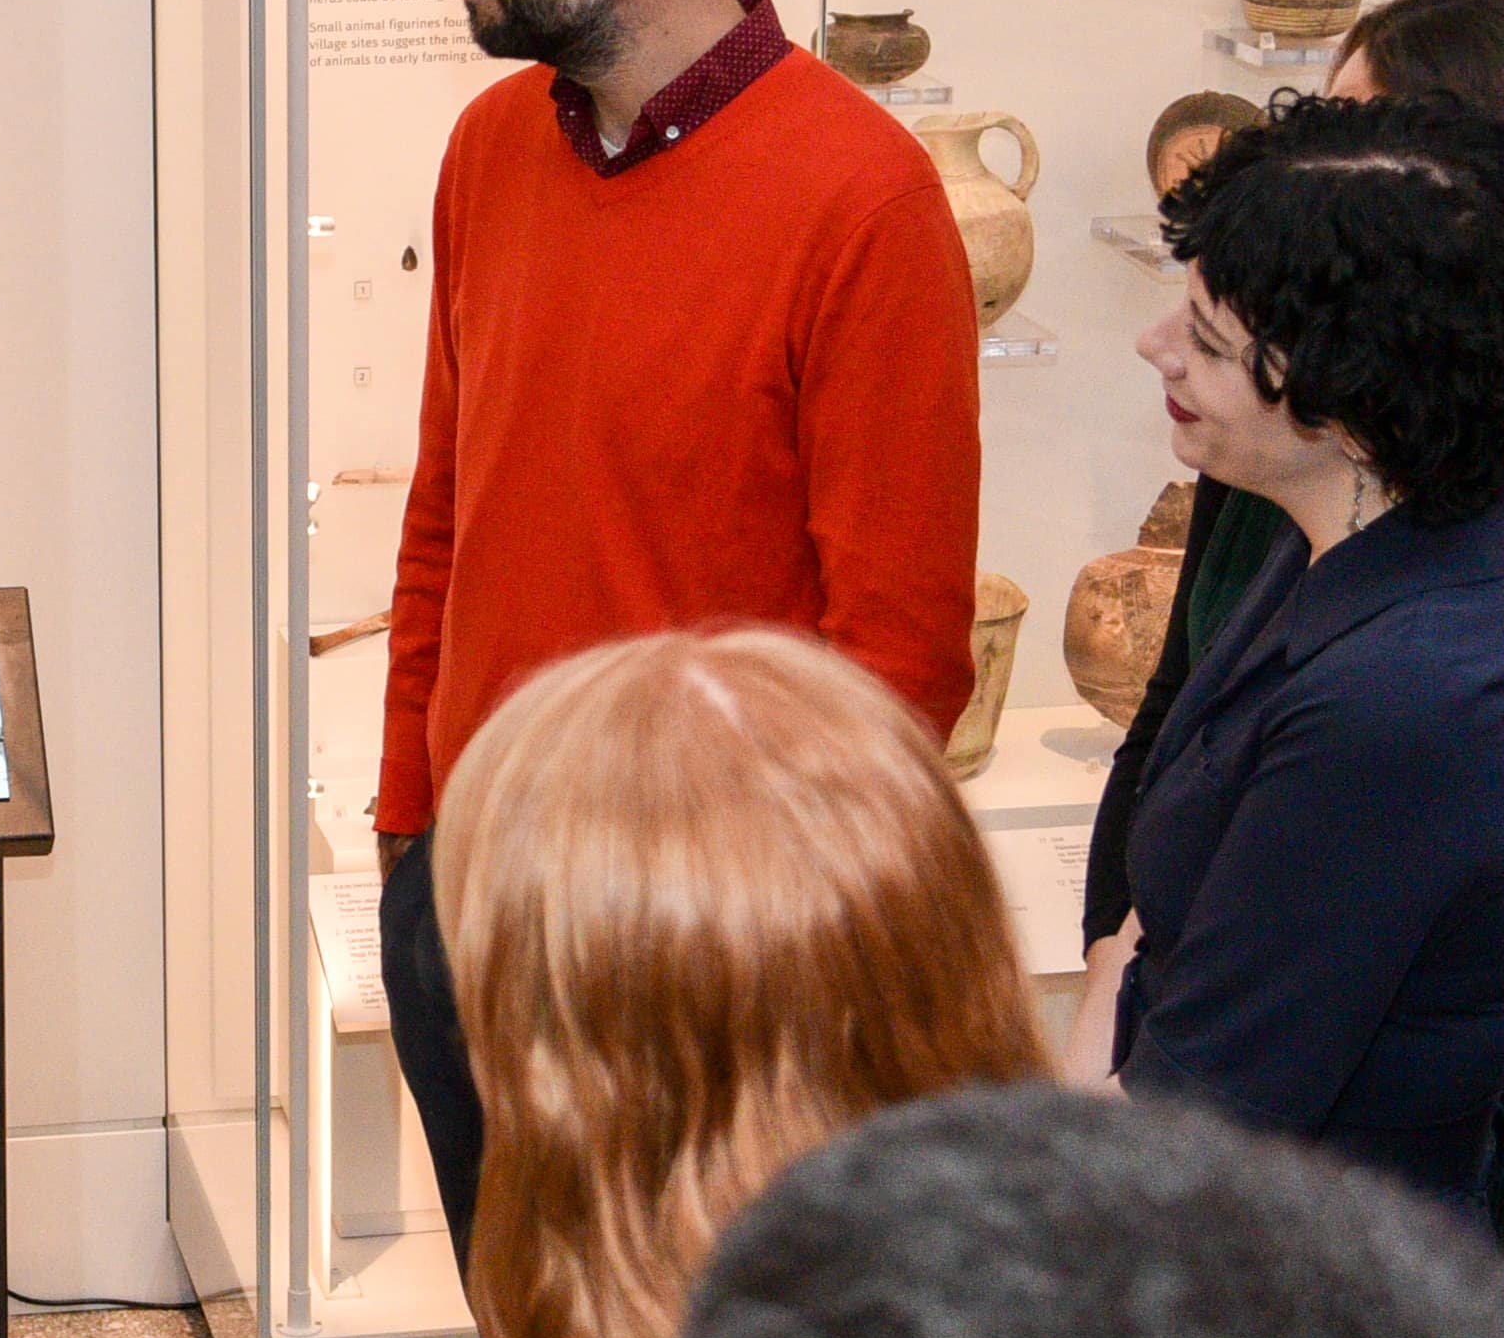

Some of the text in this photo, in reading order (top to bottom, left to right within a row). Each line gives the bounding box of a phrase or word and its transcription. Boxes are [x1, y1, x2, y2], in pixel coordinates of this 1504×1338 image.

[310, 18, 440, 32] Small animal figurines
[310, 35, 448, 51] village sites suggest the
